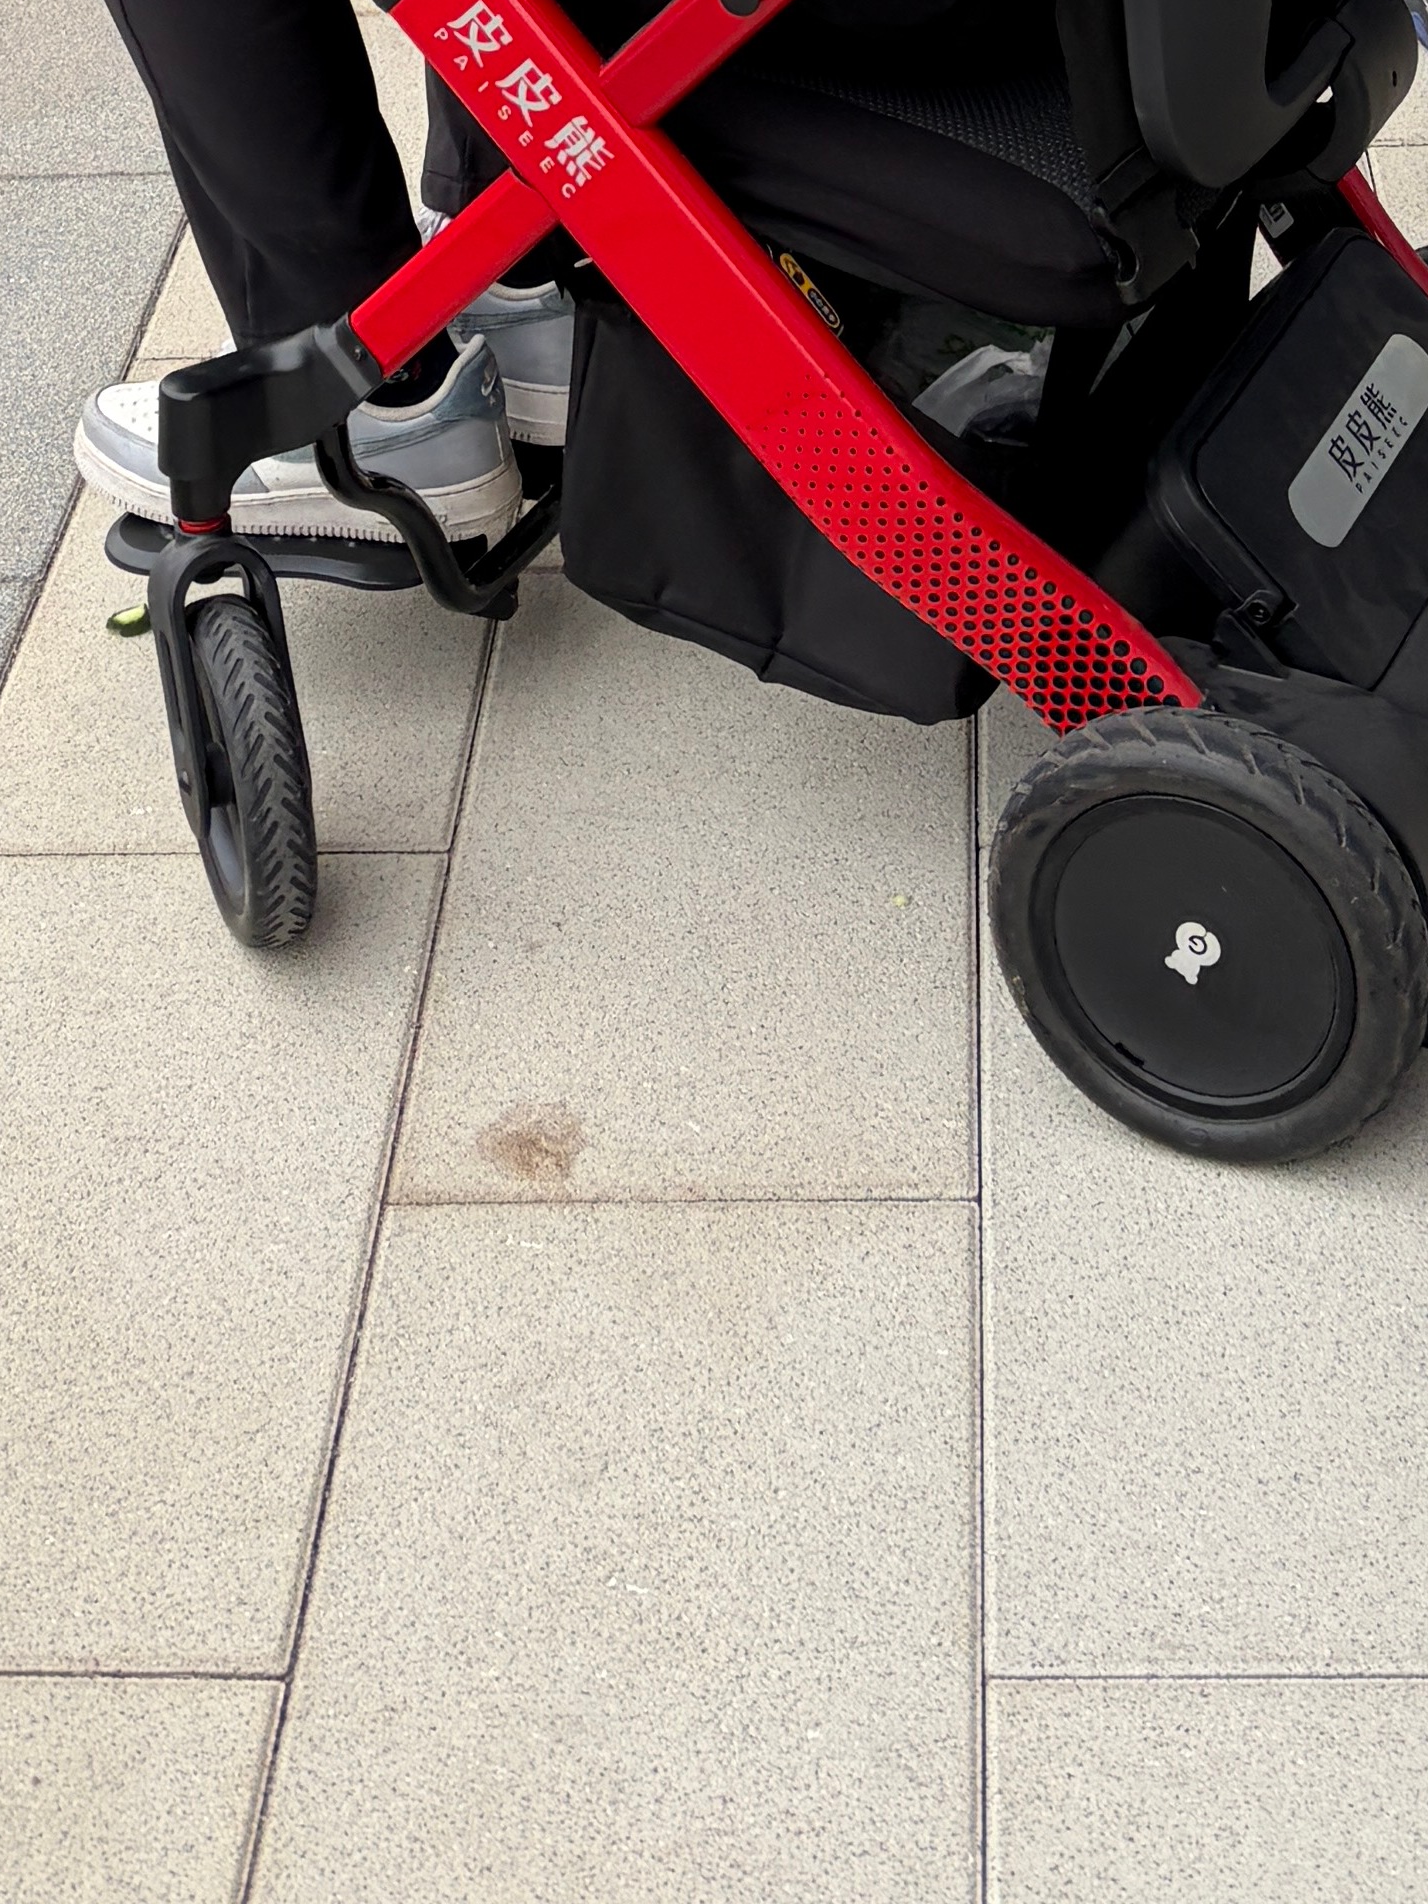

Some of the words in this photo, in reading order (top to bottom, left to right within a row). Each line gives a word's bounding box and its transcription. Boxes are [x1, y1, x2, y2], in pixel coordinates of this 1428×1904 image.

[433, 27, 577, 199] PAISEEC
[446, 0, 615, 188] 皮皮熊
[1328, 382, 1398, 483] 皮皮熊
